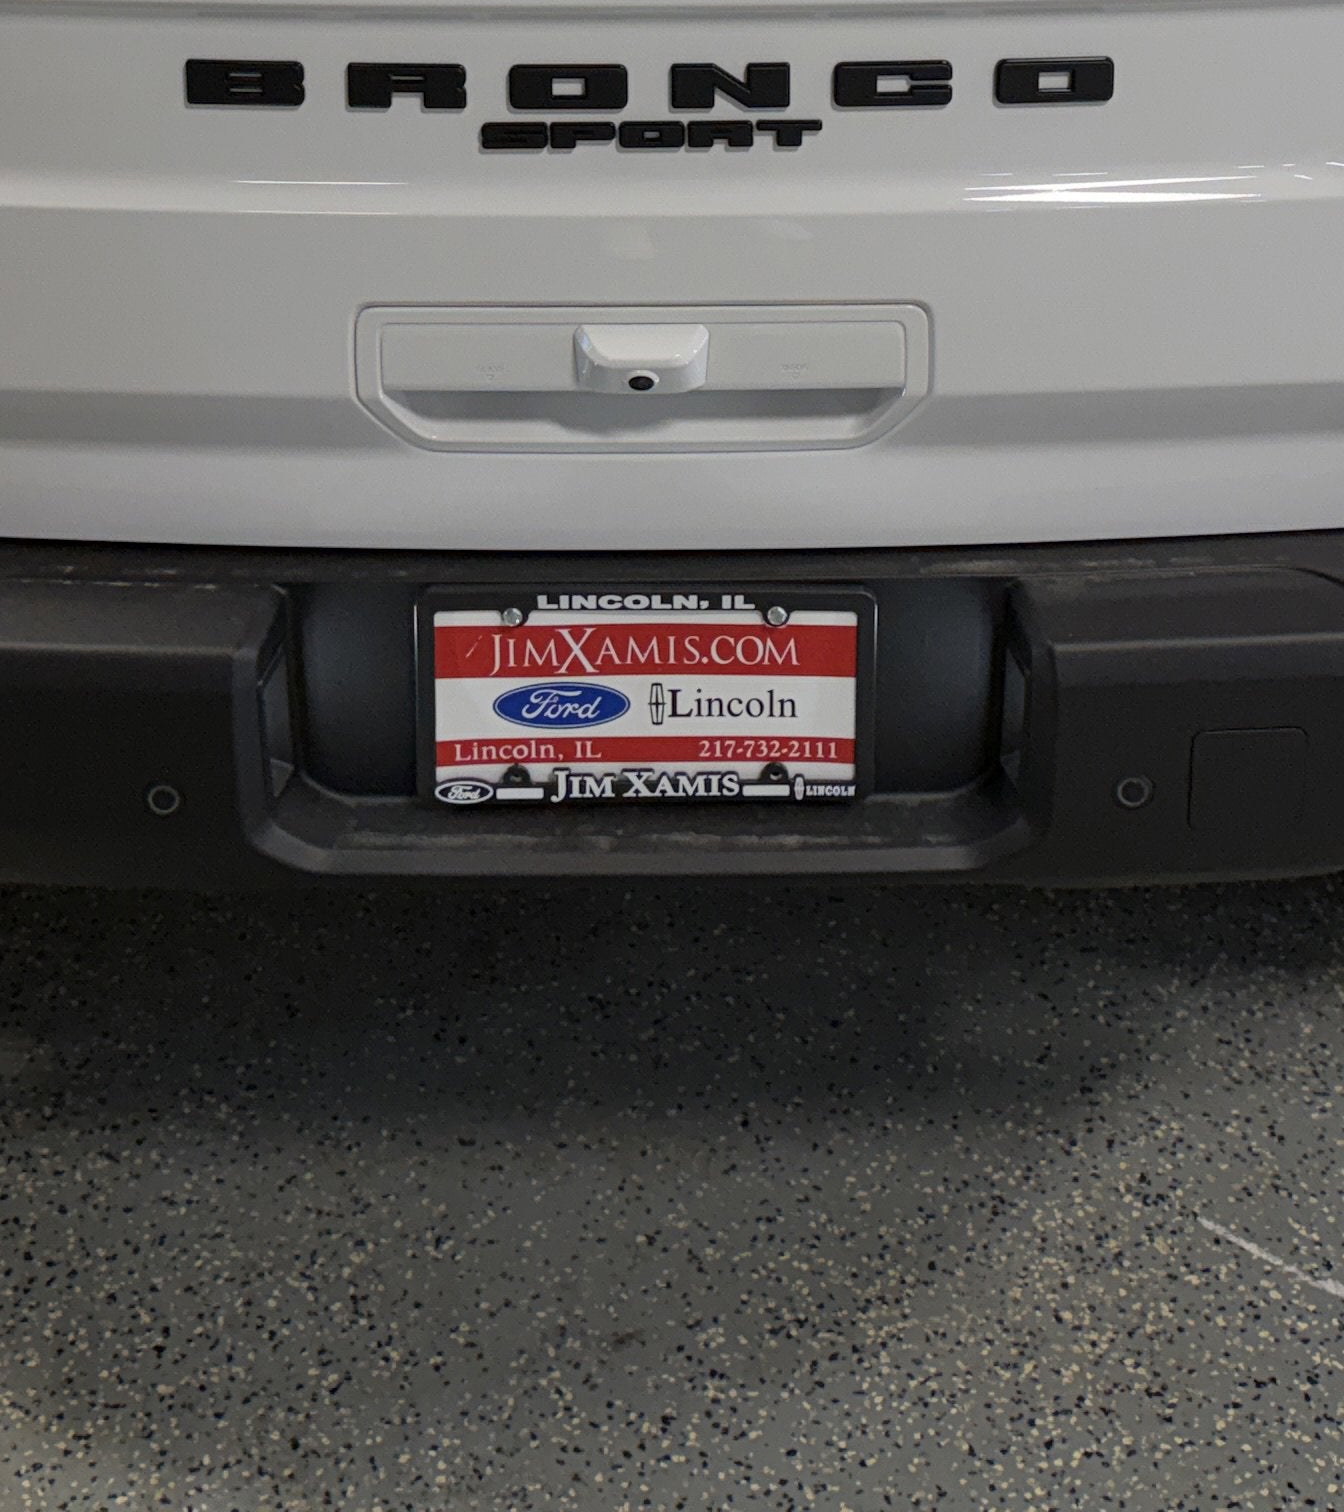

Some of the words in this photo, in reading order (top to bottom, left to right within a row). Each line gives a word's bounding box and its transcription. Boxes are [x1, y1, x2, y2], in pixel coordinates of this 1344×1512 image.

[184, 57, 1115, 110] BRONCO
[480, 119, 822, 150] SPORT
[537, 594, 710, 611] LINCOLN,
[721, 594, 756, 610] IL
[521, 689, 601, 722] Ford
[667, 688, 798, 719] Lincoln
[454, 740, 564, 762] Lincoln,
[574, 741, 602, 759] IL
[698, 740, 838, 760] 217-732-2111
[447, 785, 481, 800] Ford
[551, 769, 614, 804] JIM
[623, 770, 741, 799] XAMIS
[805, 785, 856, 797] LINCOLN
